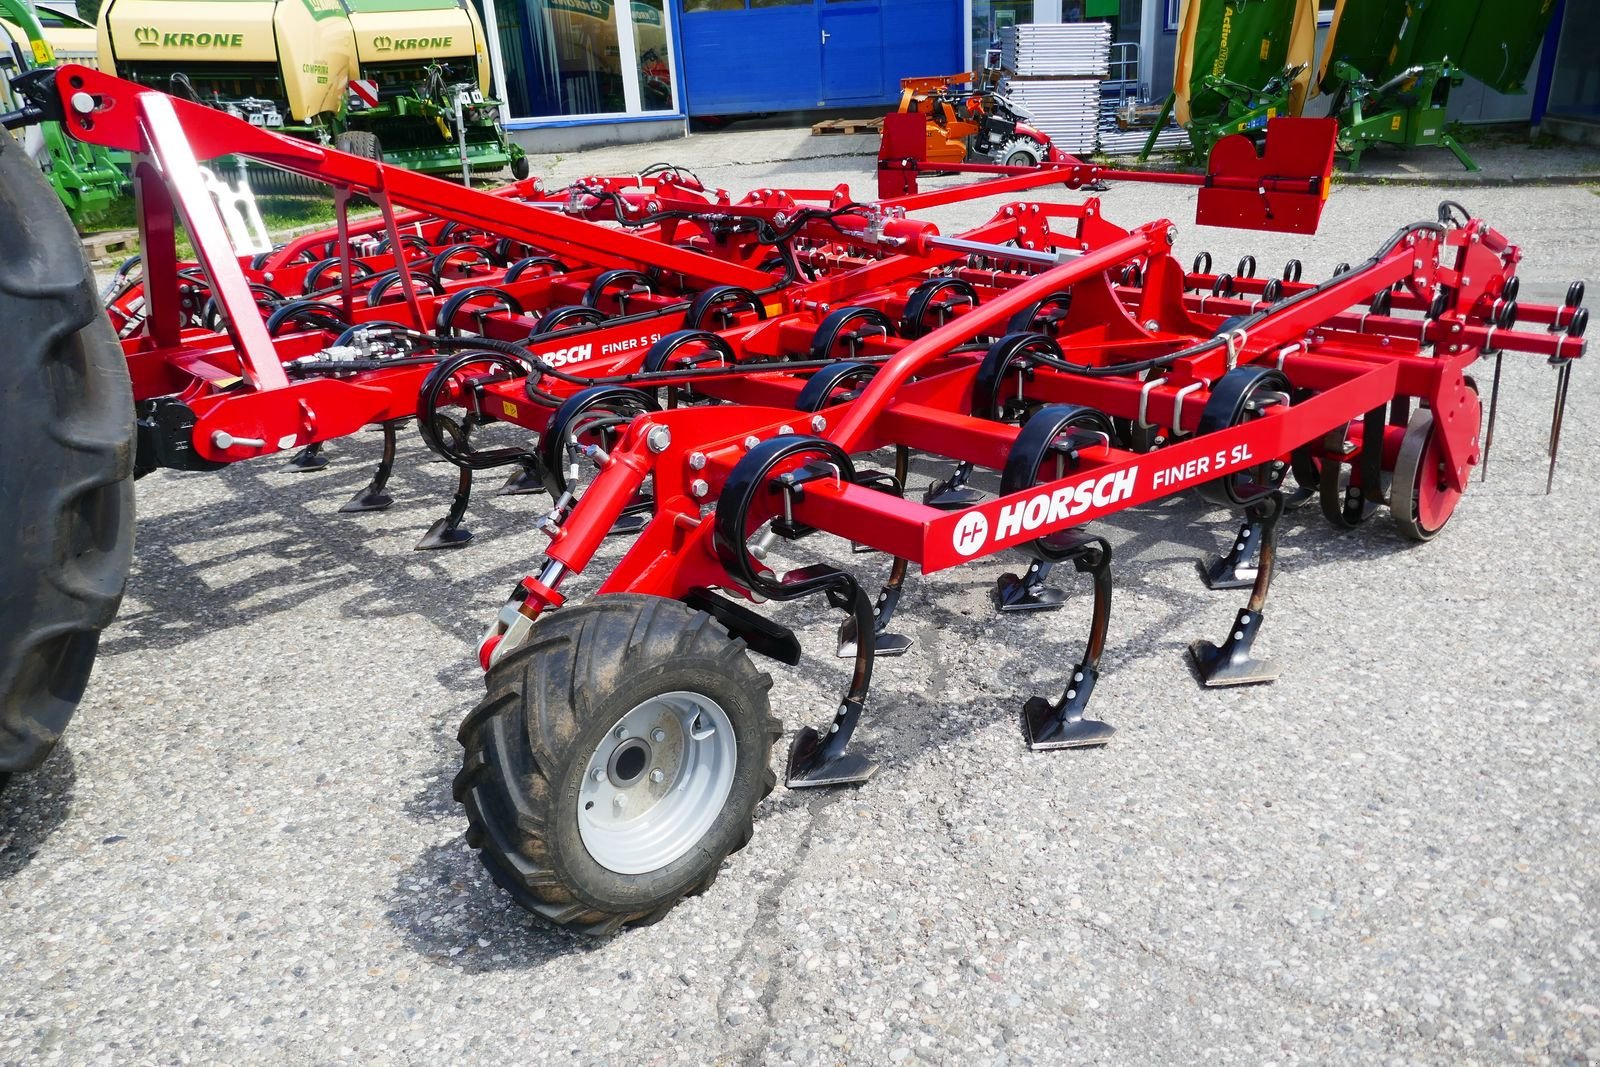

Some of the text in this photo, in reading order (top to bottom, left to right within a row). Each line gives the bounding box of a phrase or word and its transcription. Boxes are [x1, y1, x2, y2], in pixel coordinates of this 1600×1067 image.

[163, 33, 243, 47] KRONE
[394, 37, 452, 50] KRONE
[602, 338, 638, 355] FINER
[640, 336, 648, 347] 5
[995, 444, 1253, 541] HORSCH FINER 5 SL
